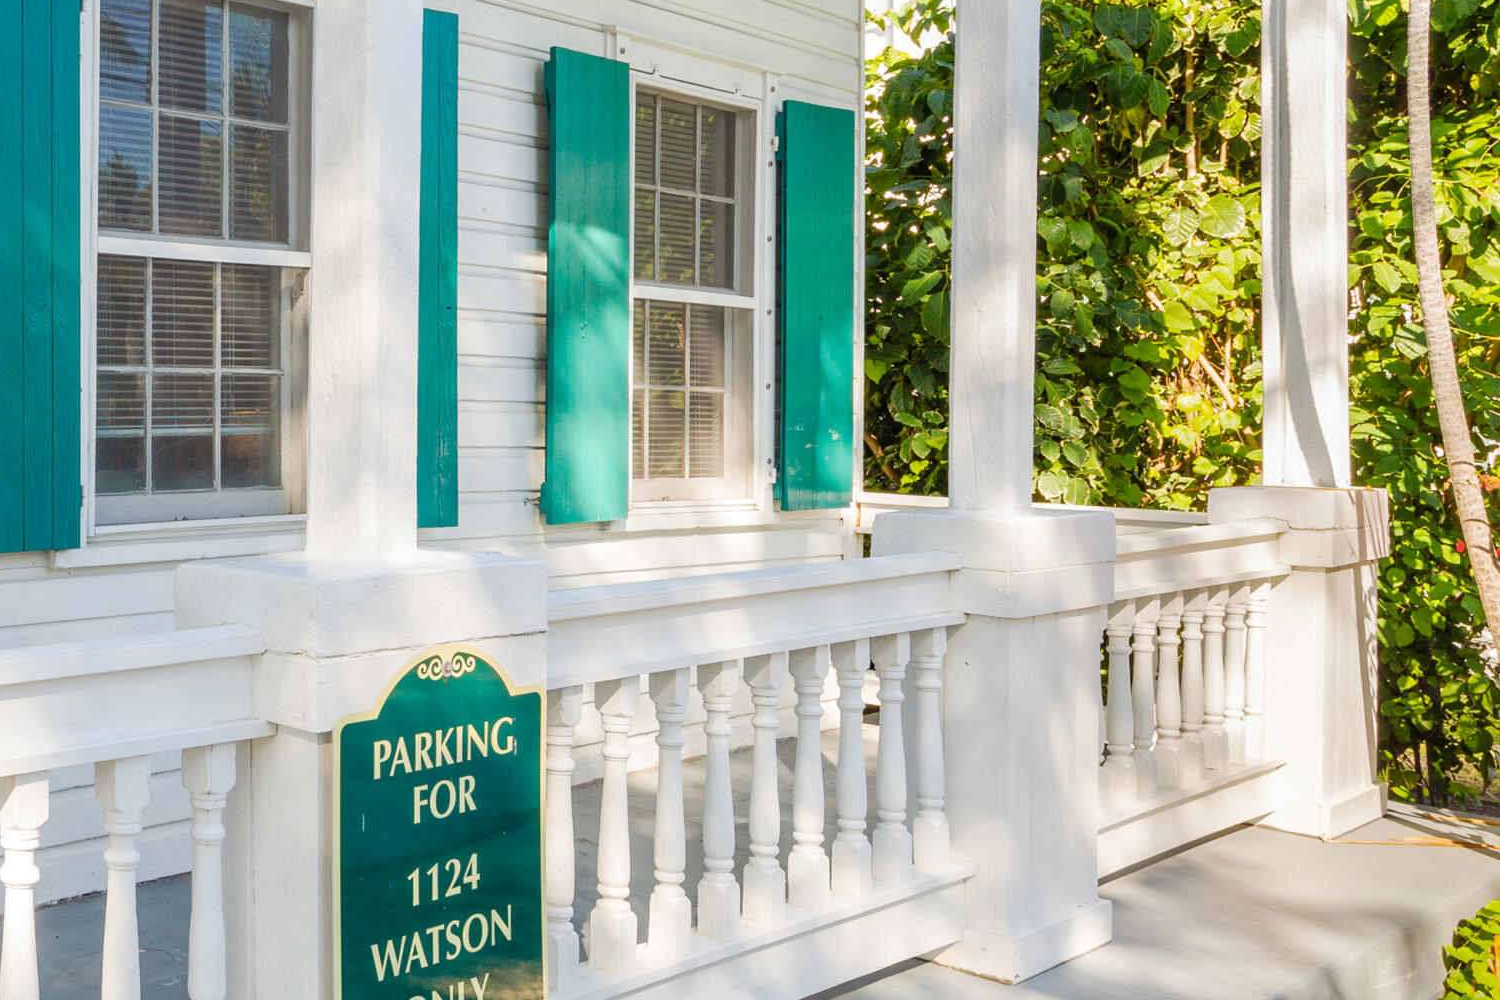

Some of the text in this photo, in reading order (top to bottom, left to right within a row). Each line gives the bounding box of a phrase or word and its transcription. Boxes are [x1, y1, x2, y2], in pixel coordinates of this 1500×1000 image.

[373, 716, 515, 780] PARKING
[413, 774, 477, 825] FOR
[407, 852, 481, 907] 1124
[370, 904, 513, 982] WATSON
